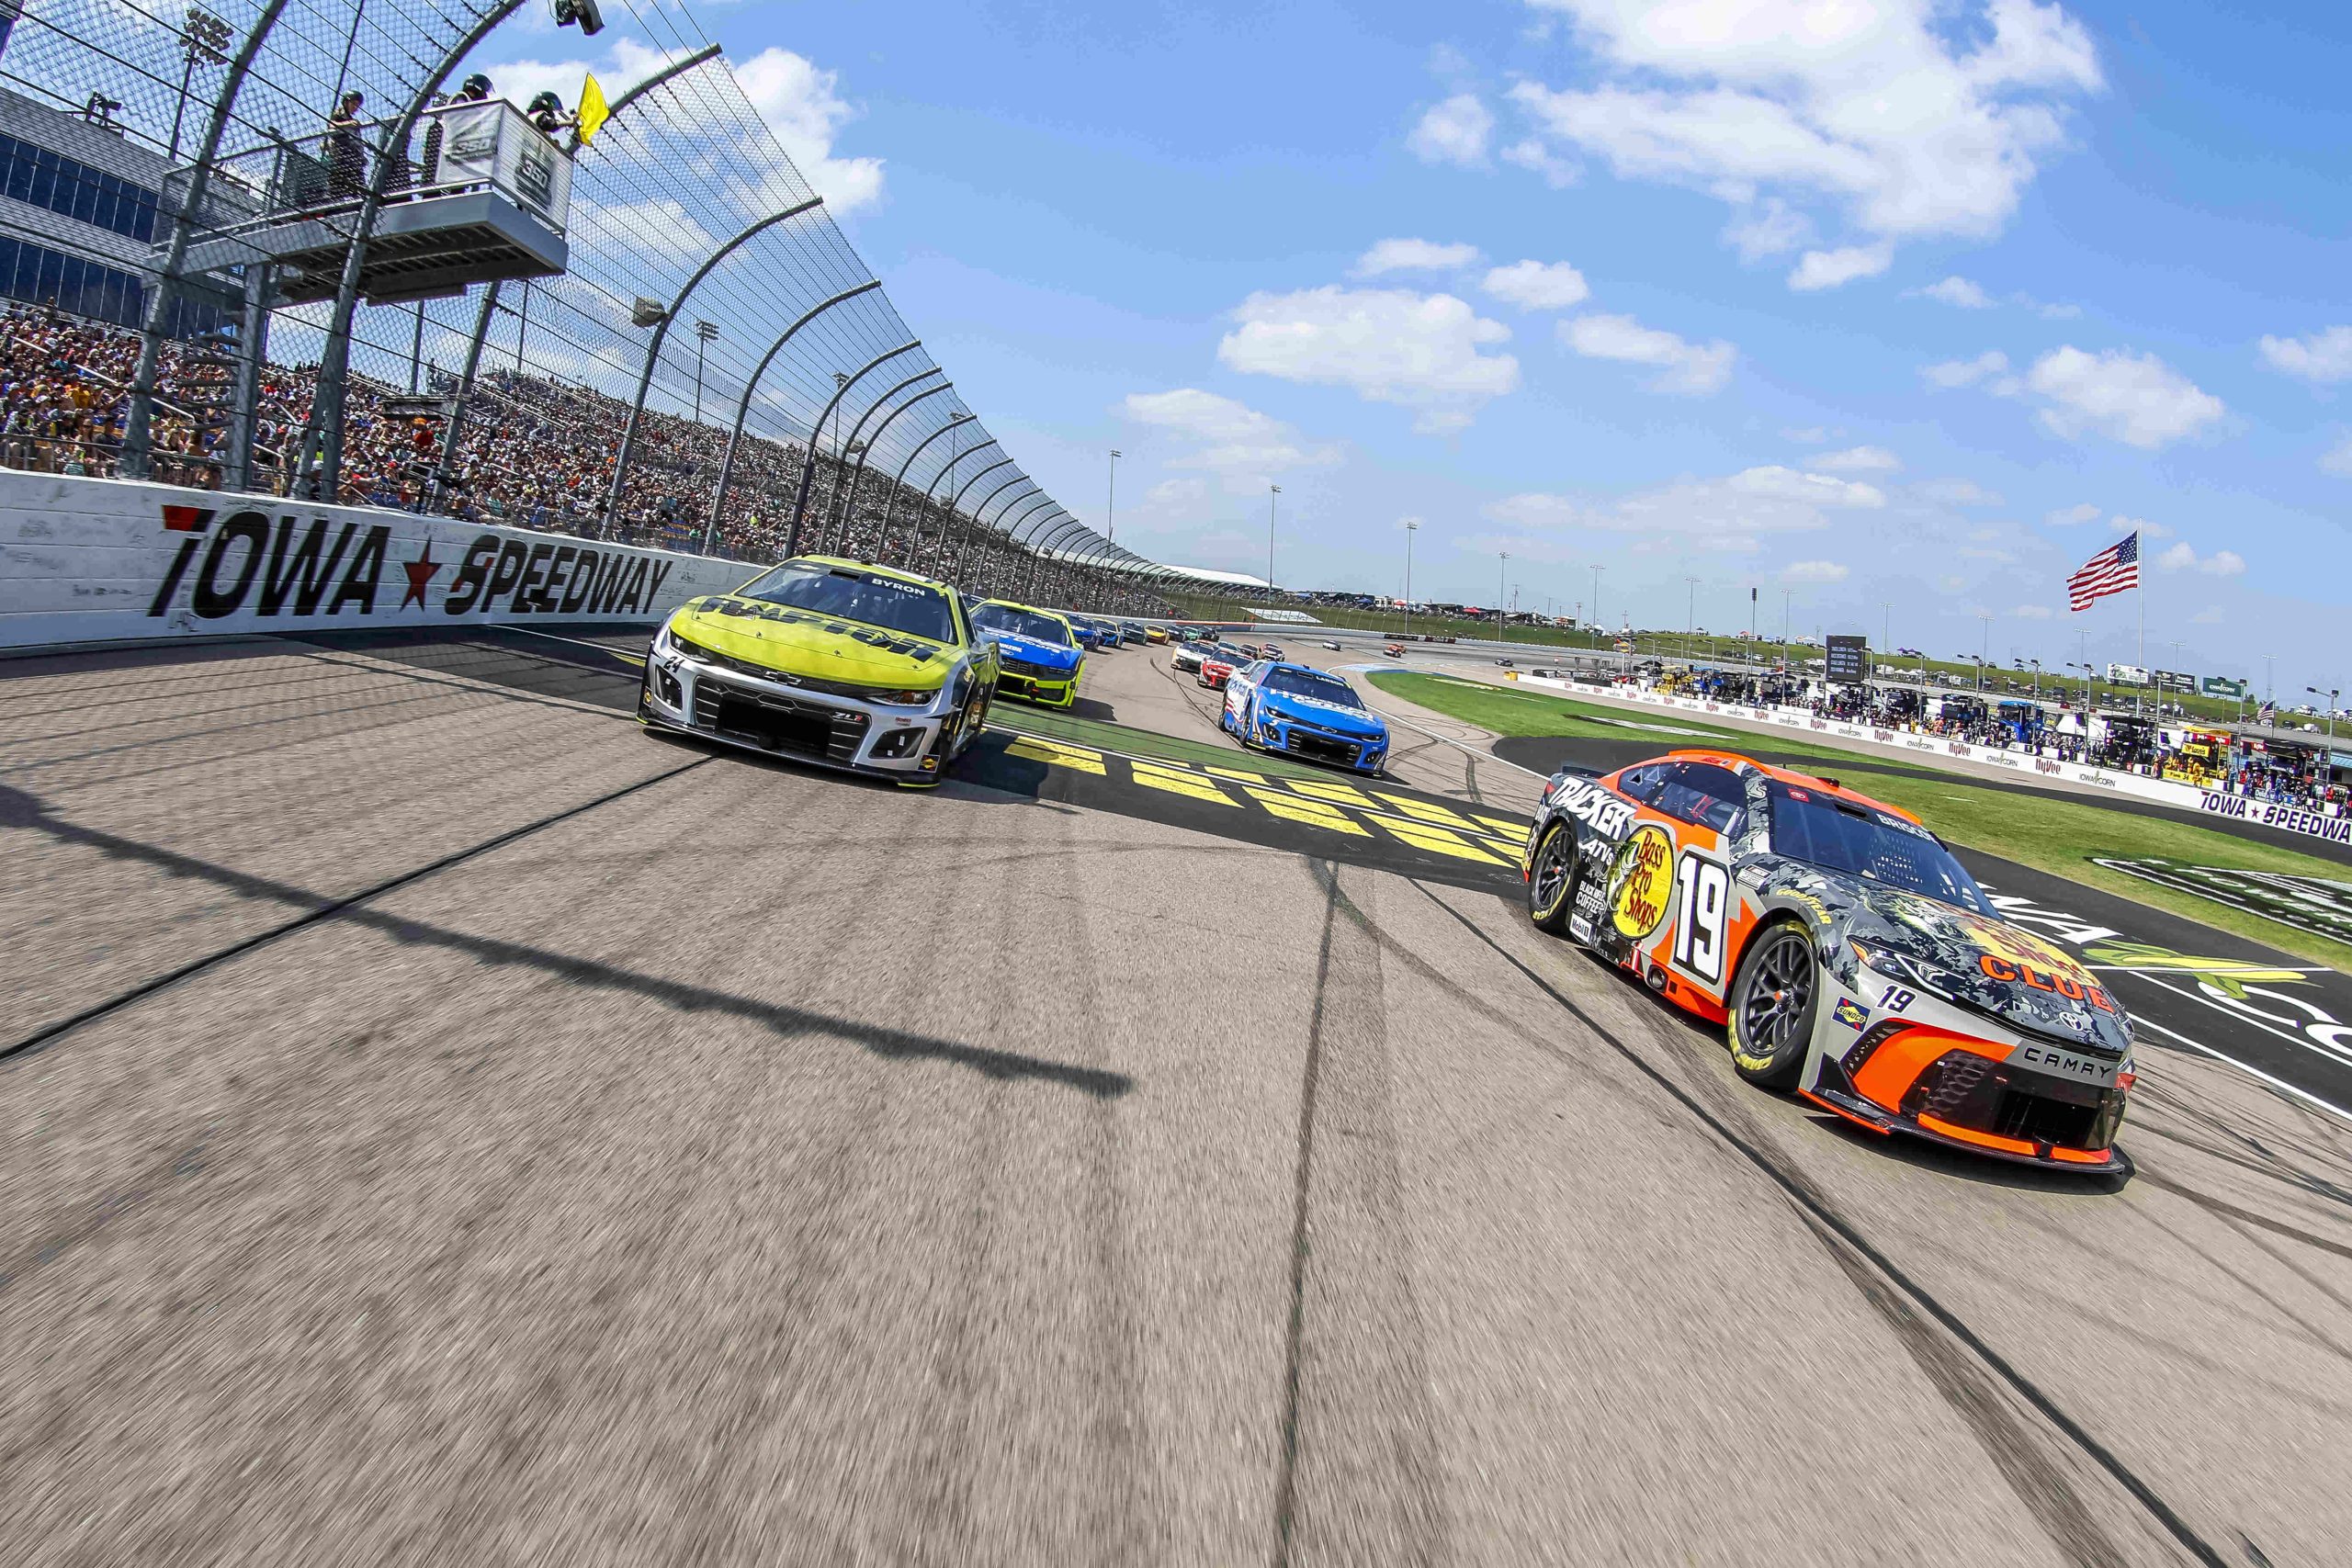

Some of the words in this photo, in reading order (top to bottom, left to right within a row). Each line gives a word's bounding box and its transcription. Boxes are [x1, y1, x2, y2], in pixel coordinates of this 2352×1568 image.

[522, 158, 549, 189] 350
[148, 504, 391, 620] IOWA
[444, 535, 674, 616] SPEEDWAY
[871, 578, 926, 596] BYRON
[663, 656, 685, 673] 24
[1316, 675, 1345, 687] LARSON
[1874, 728, 1894, 743] HyVee
[1949, 741, 1972, 758] HyVee
[1985, 754, 1999, 763] IOWA
[2002, 758, 2018, 767] CORN
[2035, 758, 2061, 775] HyVee
[2078, 773, 2094, 783] IOWA
[2098, 776, 2116, 787] CORN
[1548, 776, 1638, 841] TRACKER
[2200, 791, 2246, 818] IOWA
[2263, 806, 2351, 844] SPEEDWA
[1579, 838, 1615, 866] ATVs
[1637, 830, 1667, 871] Bass
[1578, 880, 1596, 897] BLACK
[1631, 860, 1653, 895] Pro
[1576, 891, 1600, 914] COFFEE
[1624, 887, 1658, 934] Shops
[1776, 888, 1832, 924] GOODYEAR
[1572, 919, 1584, 934] Mobil
[1676, 852, 1727, 980] 19
[1877, 985, 1915, 1013] 19
[1837, 1006, 1866, 1023] SUNOCO
[2023, 1047, 2112, 1079] CAMRY
